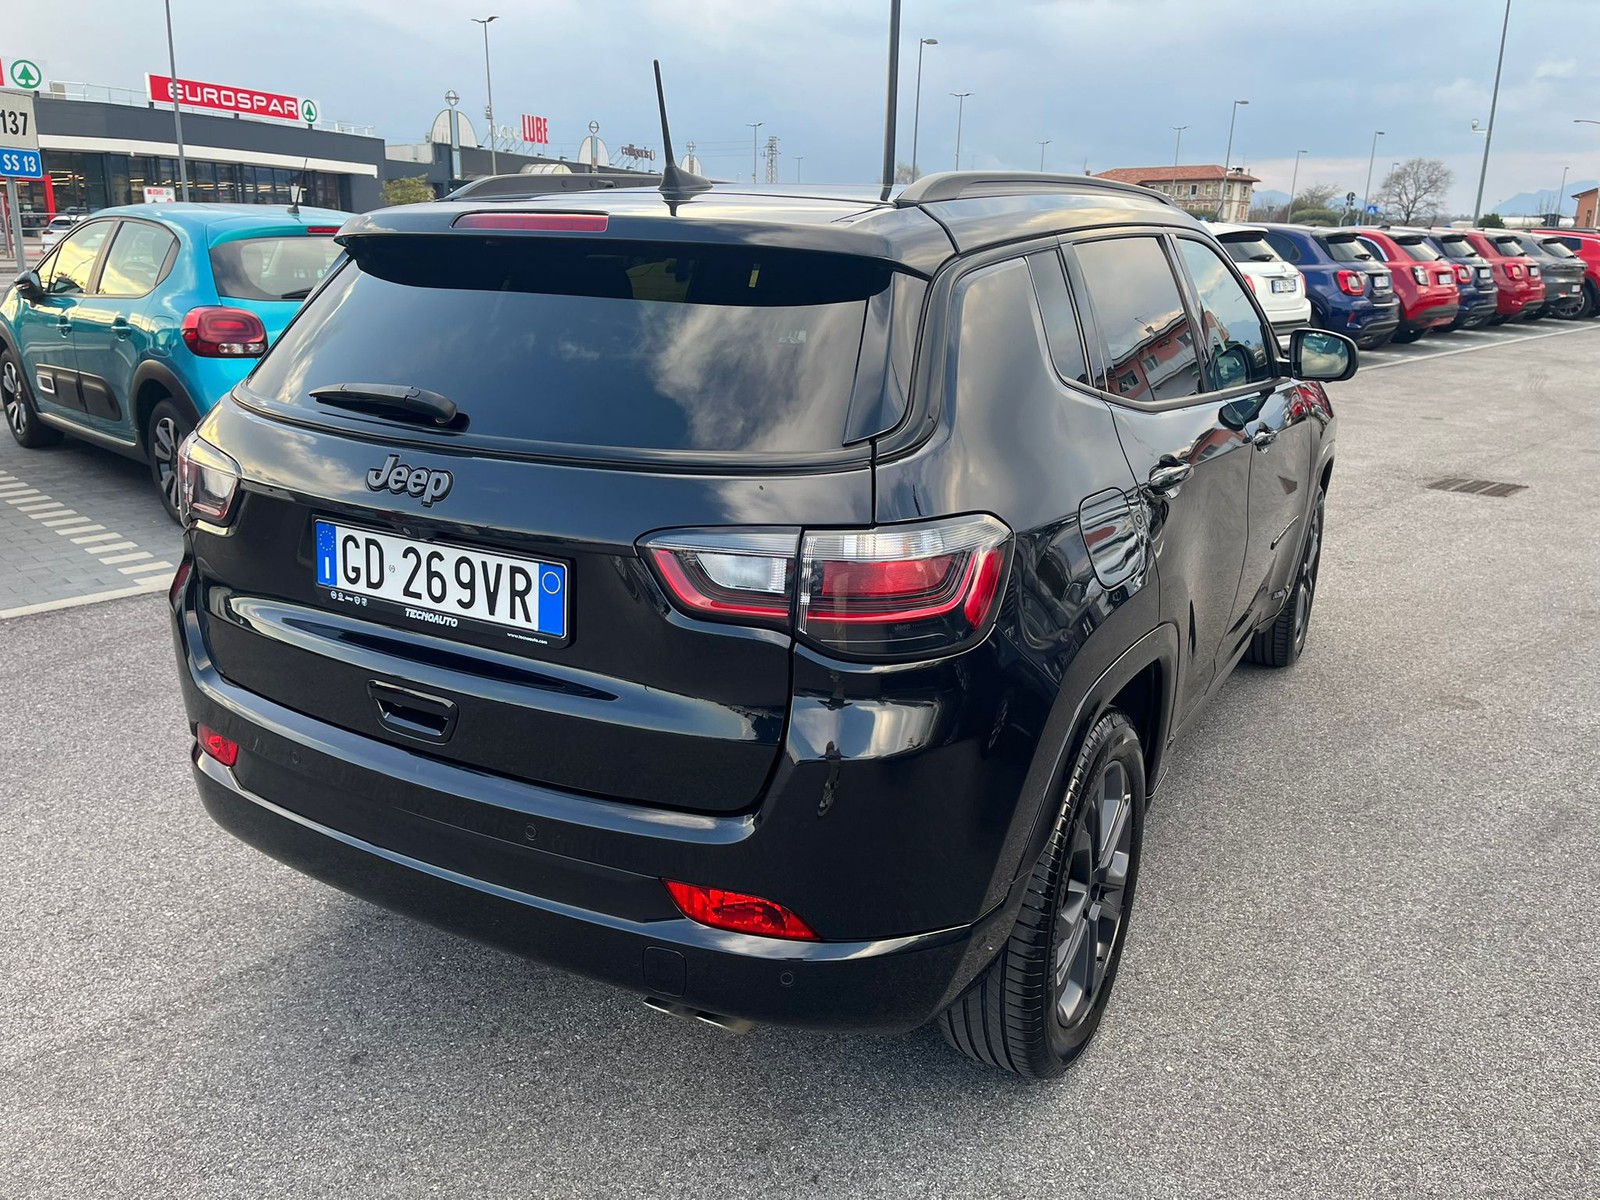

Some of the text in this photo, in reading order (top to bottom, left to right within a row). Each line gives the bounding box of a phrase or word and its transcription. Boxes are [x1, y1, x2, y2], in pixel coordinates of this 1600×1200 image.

[168, 82, 297, 116] EUROSPAR
[0, 109, 27, 136] 137
[521, 114, 549, 145] LUBE
[3, 153, 37, 173] SS 13
[366, 454, 454, 507] Jeep
[342, 534, 385, 590] GD
[402, 546, 532, 623] 269VR
[405, 608, 458, 627] TECNOAUTO
